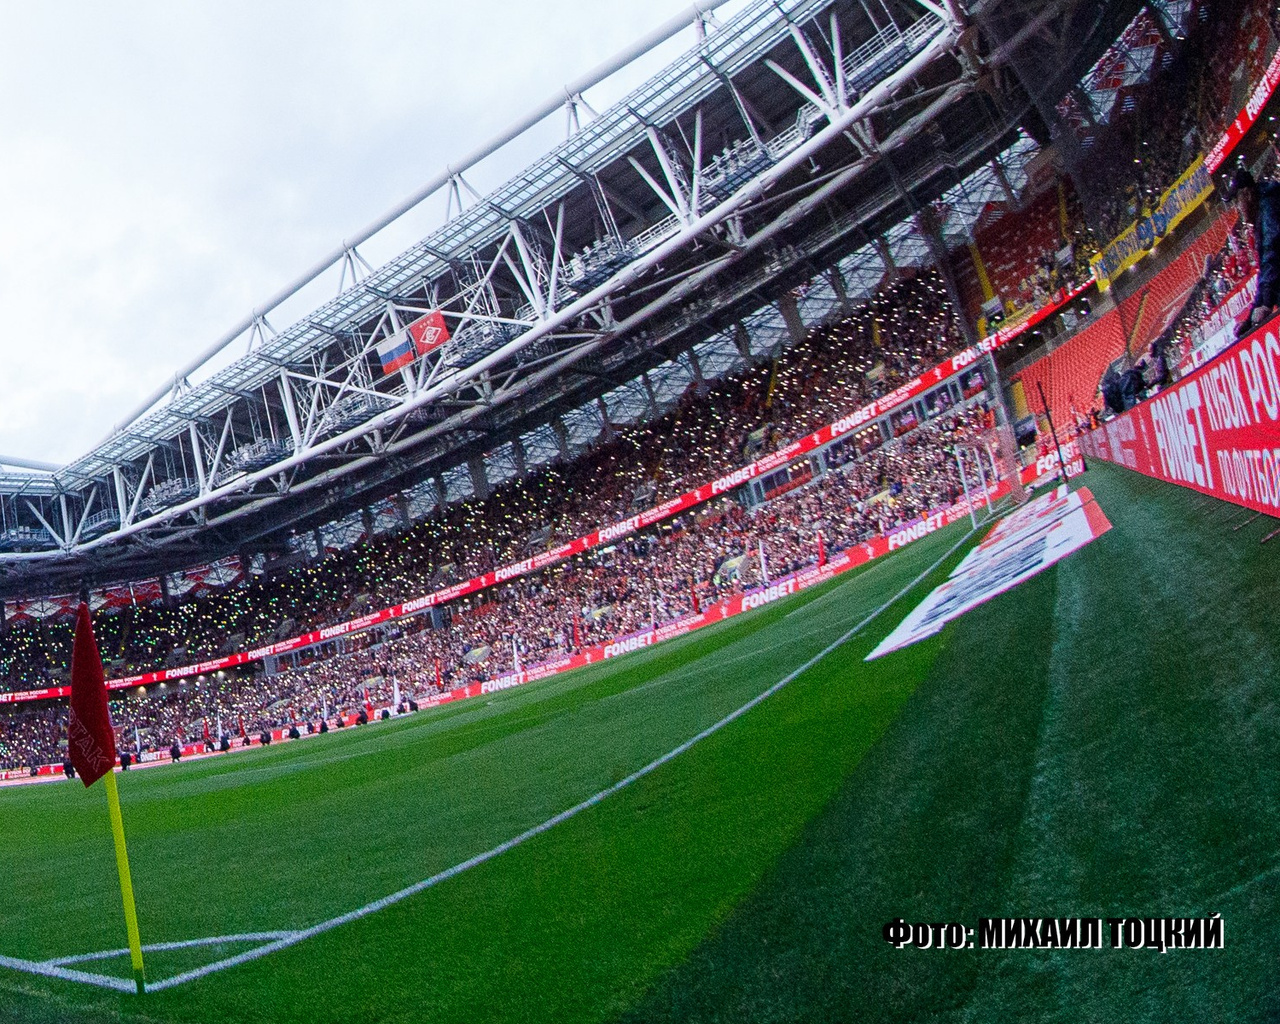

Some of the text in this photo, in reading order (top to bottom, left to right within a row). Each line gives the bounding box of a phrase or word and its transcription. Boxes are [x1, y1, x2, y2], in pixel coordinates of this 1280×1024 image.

[1199, 357, 1251, 430] КУБОК
[831, 401, 878, 436] FONBET
[1150, 380, 1214, 490] FONBET
[712, 463, 757, 494] FONBET
[1217, 449, 1236, 496] ПО
[598, 516, 641, 542] FONBET
[888, 511, 944, 550] FONBET
[495, 558, 533, 582] FONBET
[401, 593, 435, 614] FONBET
[741, 579, 795, 611] FONBET
[320, 622, 350, 639] FONBET
[248, 645, 274, 660] FONBET
[604, 632, 654, 659] FONBET
[165, 665, 199, 678] FONBET
[481, 671, 526, 694] FONBET
